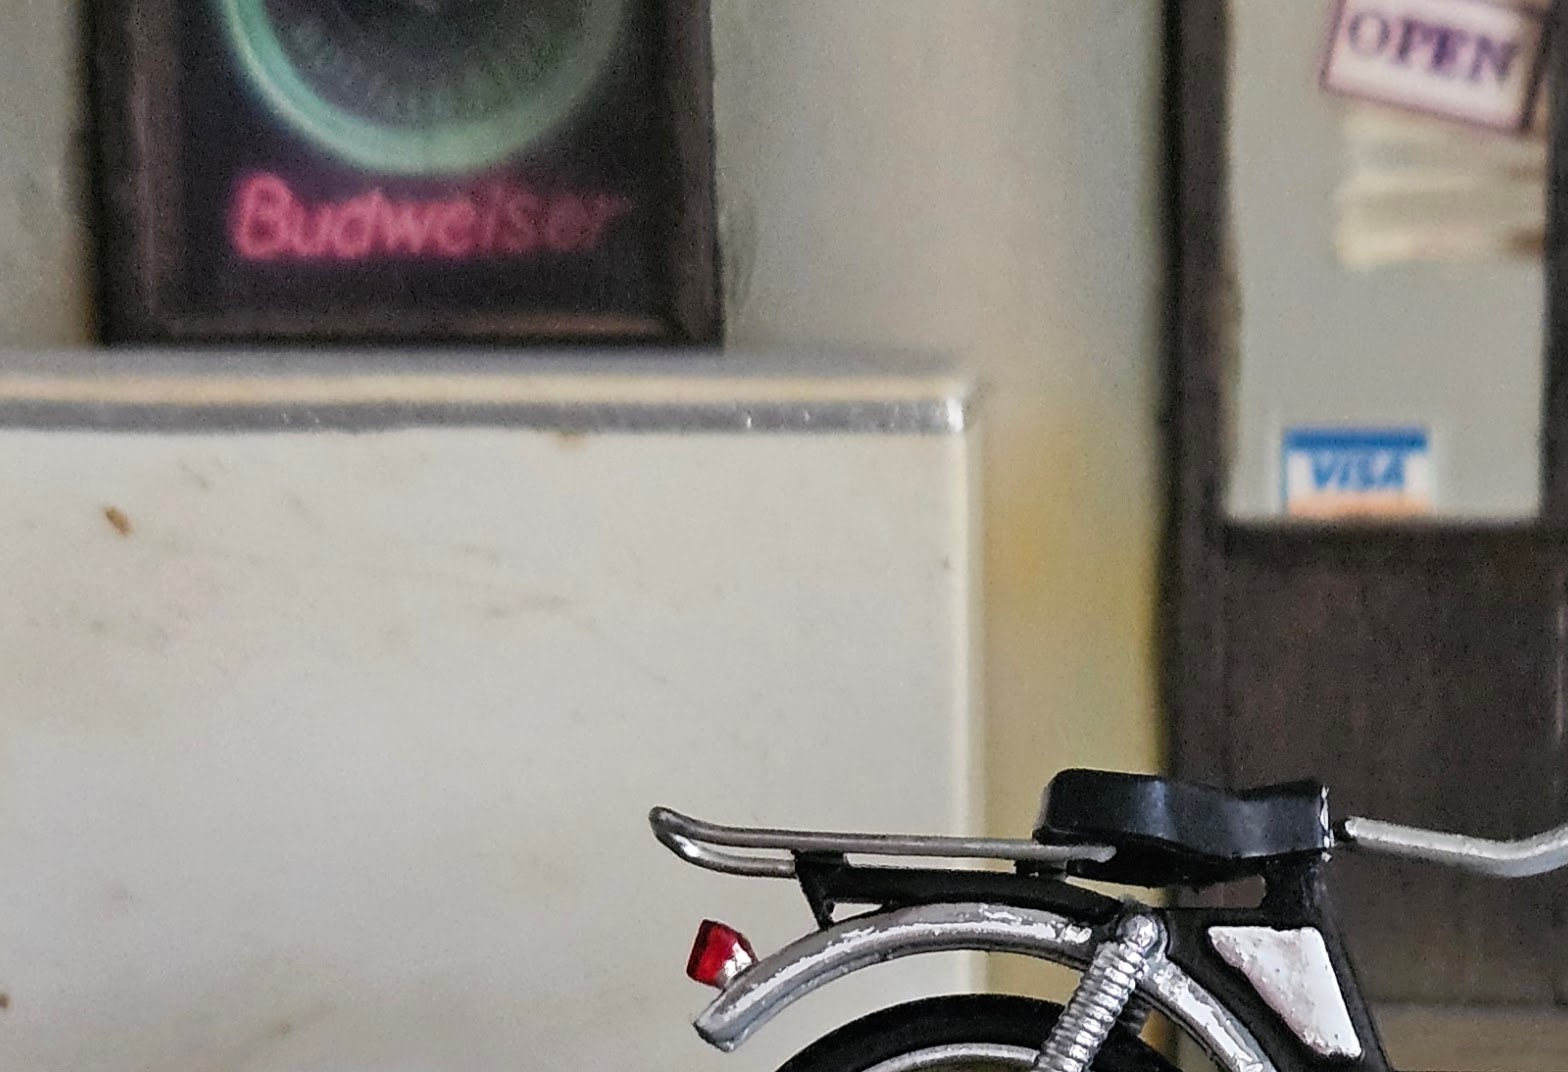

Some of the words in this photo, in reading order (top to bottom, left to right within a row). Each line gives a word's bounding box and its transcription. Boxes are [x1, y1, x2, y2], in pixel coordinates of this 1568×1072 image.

[1347, 11, 1520, 83] OPEN
[233, 172, 628, 259] Budweiser
[1311, 450, 1406, 490] VISA
